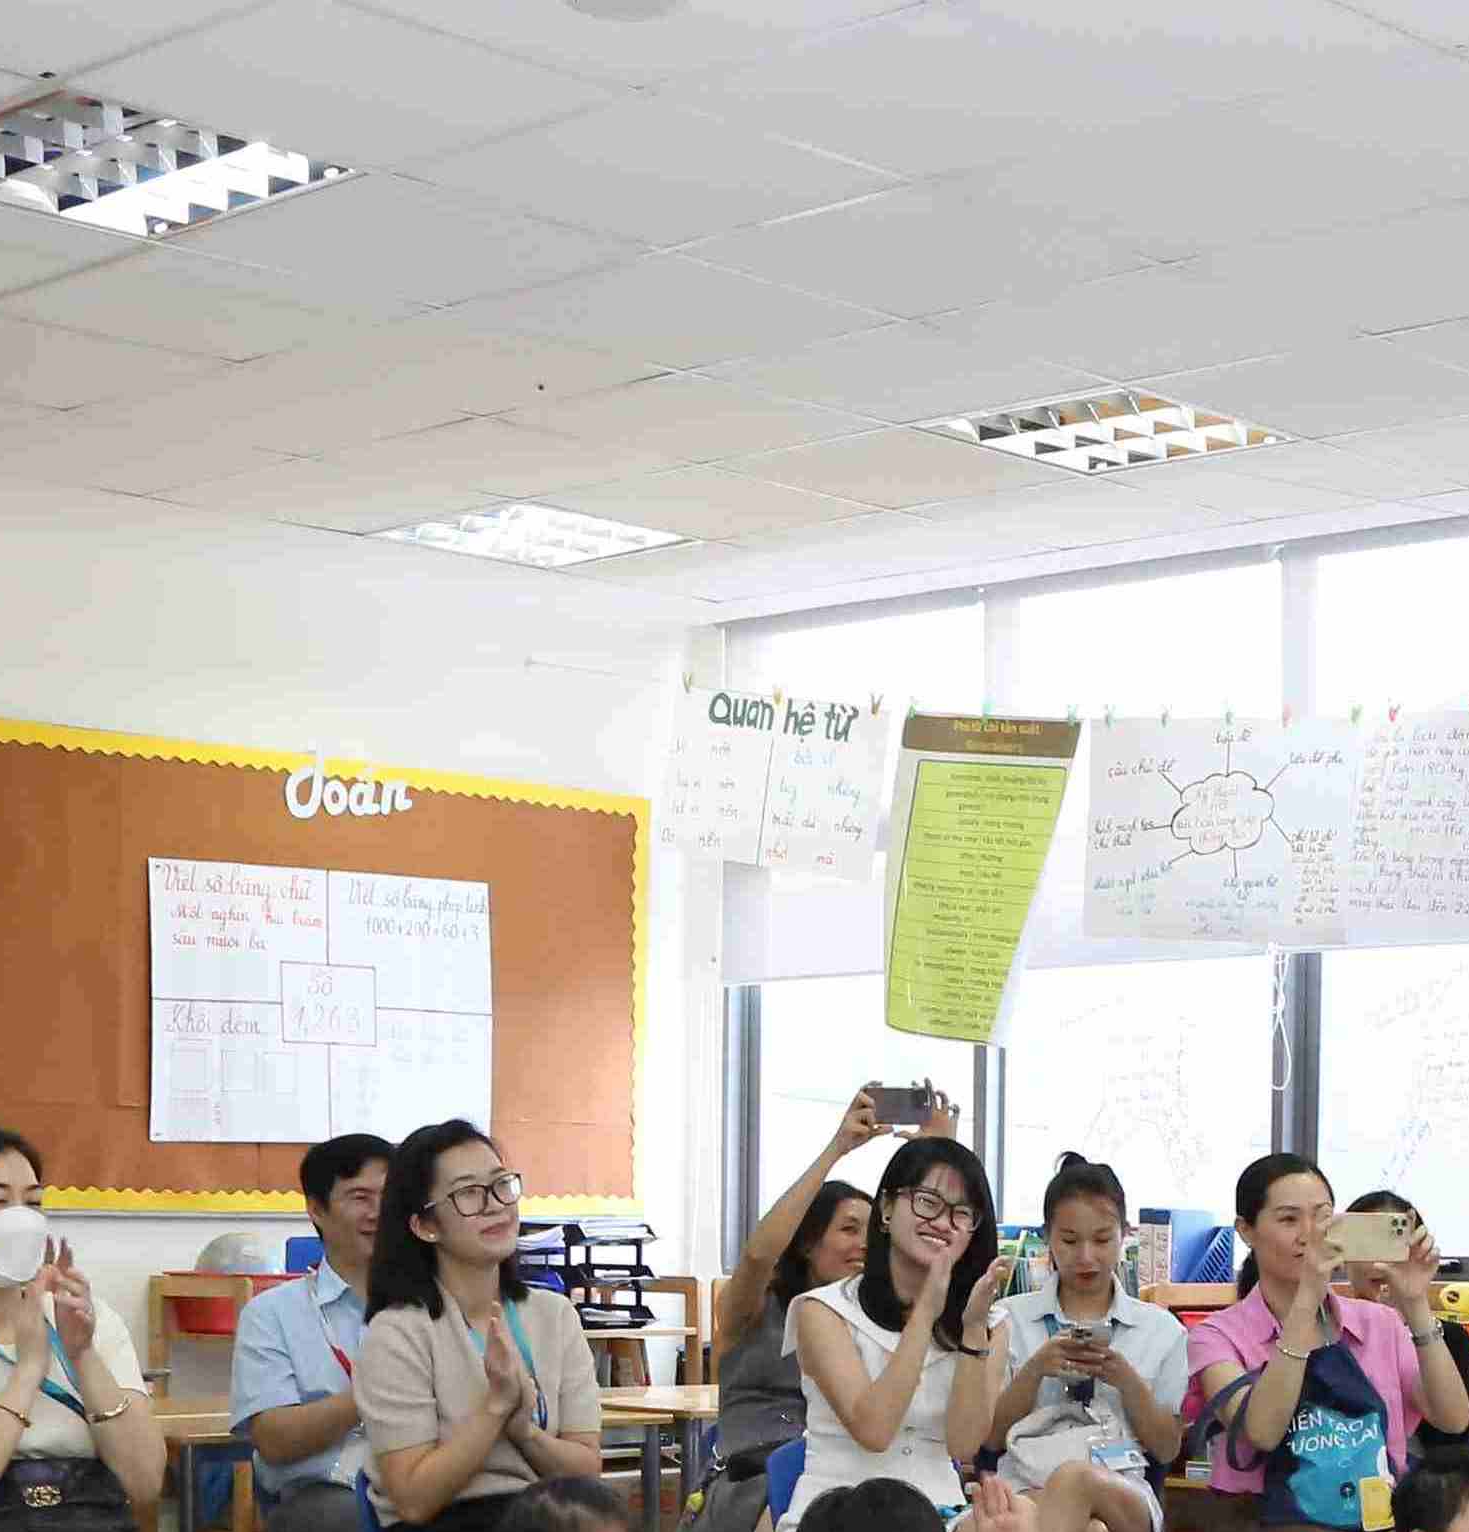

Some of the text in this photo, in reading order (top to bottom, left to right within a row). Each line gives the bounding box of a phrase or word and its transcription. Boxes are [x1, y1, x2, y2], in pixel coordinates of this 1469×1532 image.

[708, 692, 861, 744] Quan hệ từ
[1287, 1407, 1323, 1433] IẾN
